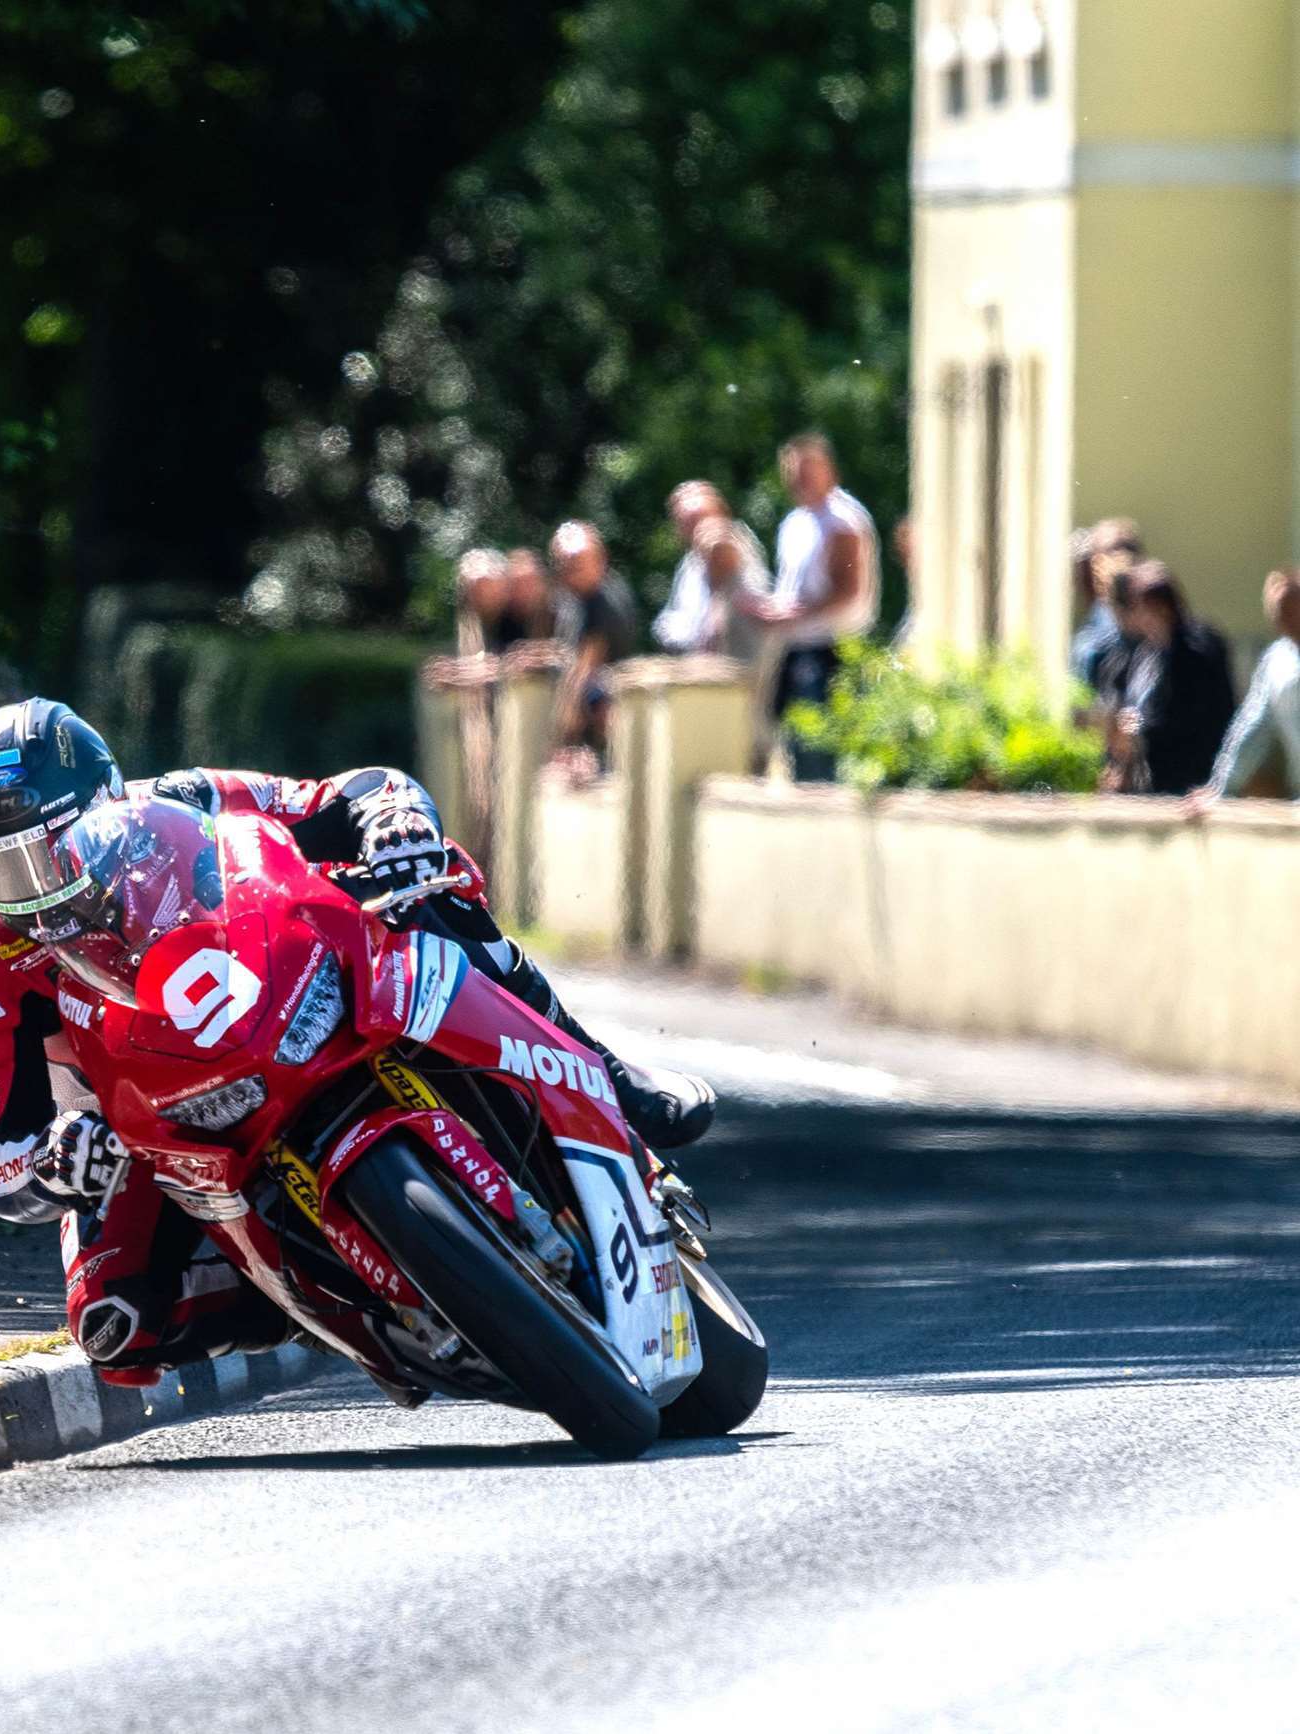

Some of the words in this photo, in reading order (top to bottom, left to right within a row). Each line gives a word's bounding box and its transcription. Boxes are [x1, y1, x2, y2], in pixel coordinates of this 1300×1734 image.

[162, 947, 262, 1048] 9
[499, 1034, 618, 1107] MOTUL
[331, 1128, 376, 1172] HONDA
[433, 1118, 500, 1203] DUNLOP
[322, 1223, 401, 1296] DUNLOP
[610, 1222, 639, 1305] 9
